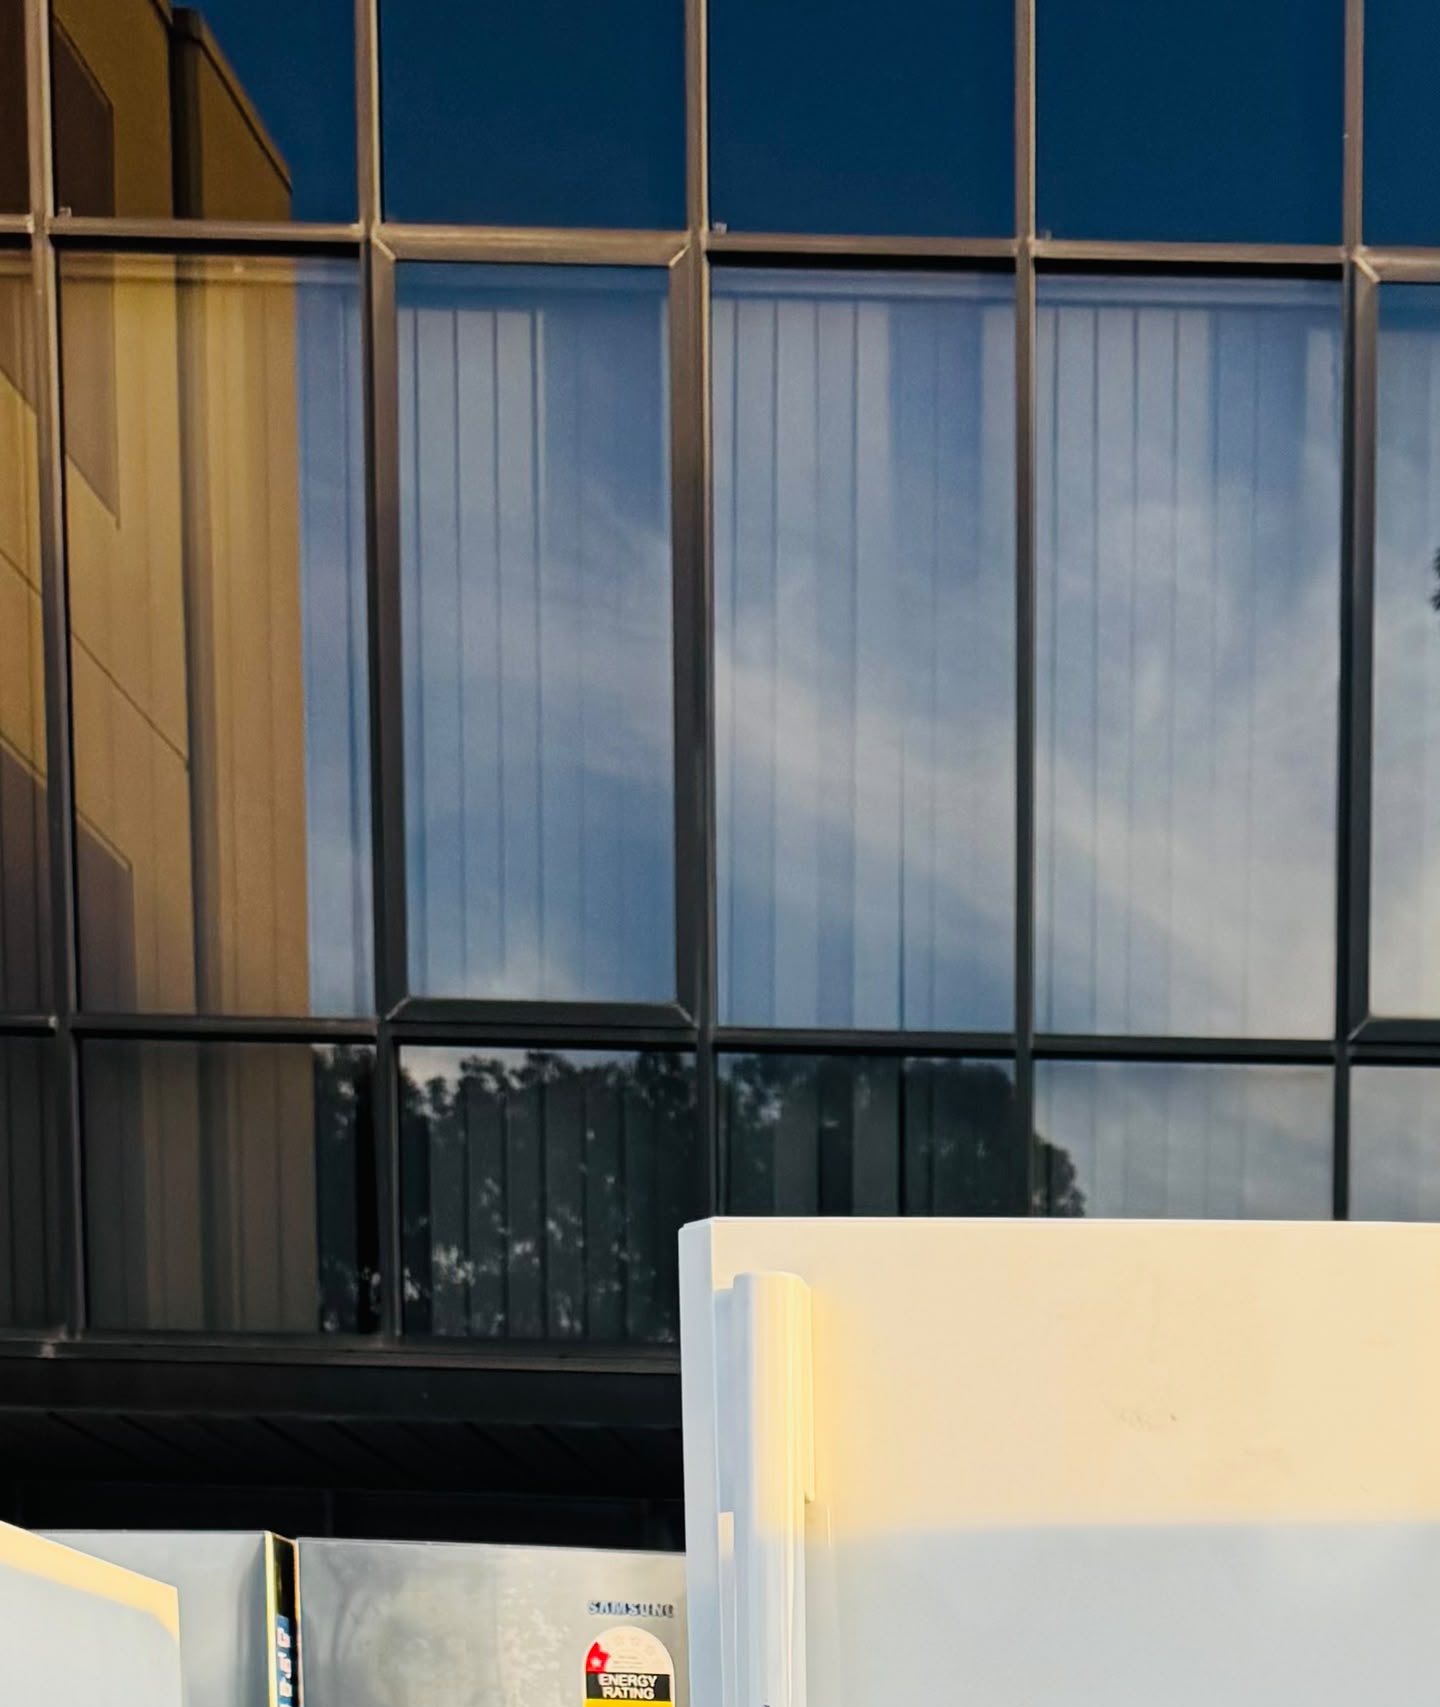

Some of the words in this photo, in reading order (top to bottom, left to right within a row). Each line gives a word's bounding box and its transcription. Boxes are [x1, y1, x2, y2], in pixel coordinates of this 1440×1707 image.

[588, 1601, 675, 1618] SAMSUNG
[598, 1674, 658, 1687] ENERGY
[602, 1687, 655, 1700] RATING
